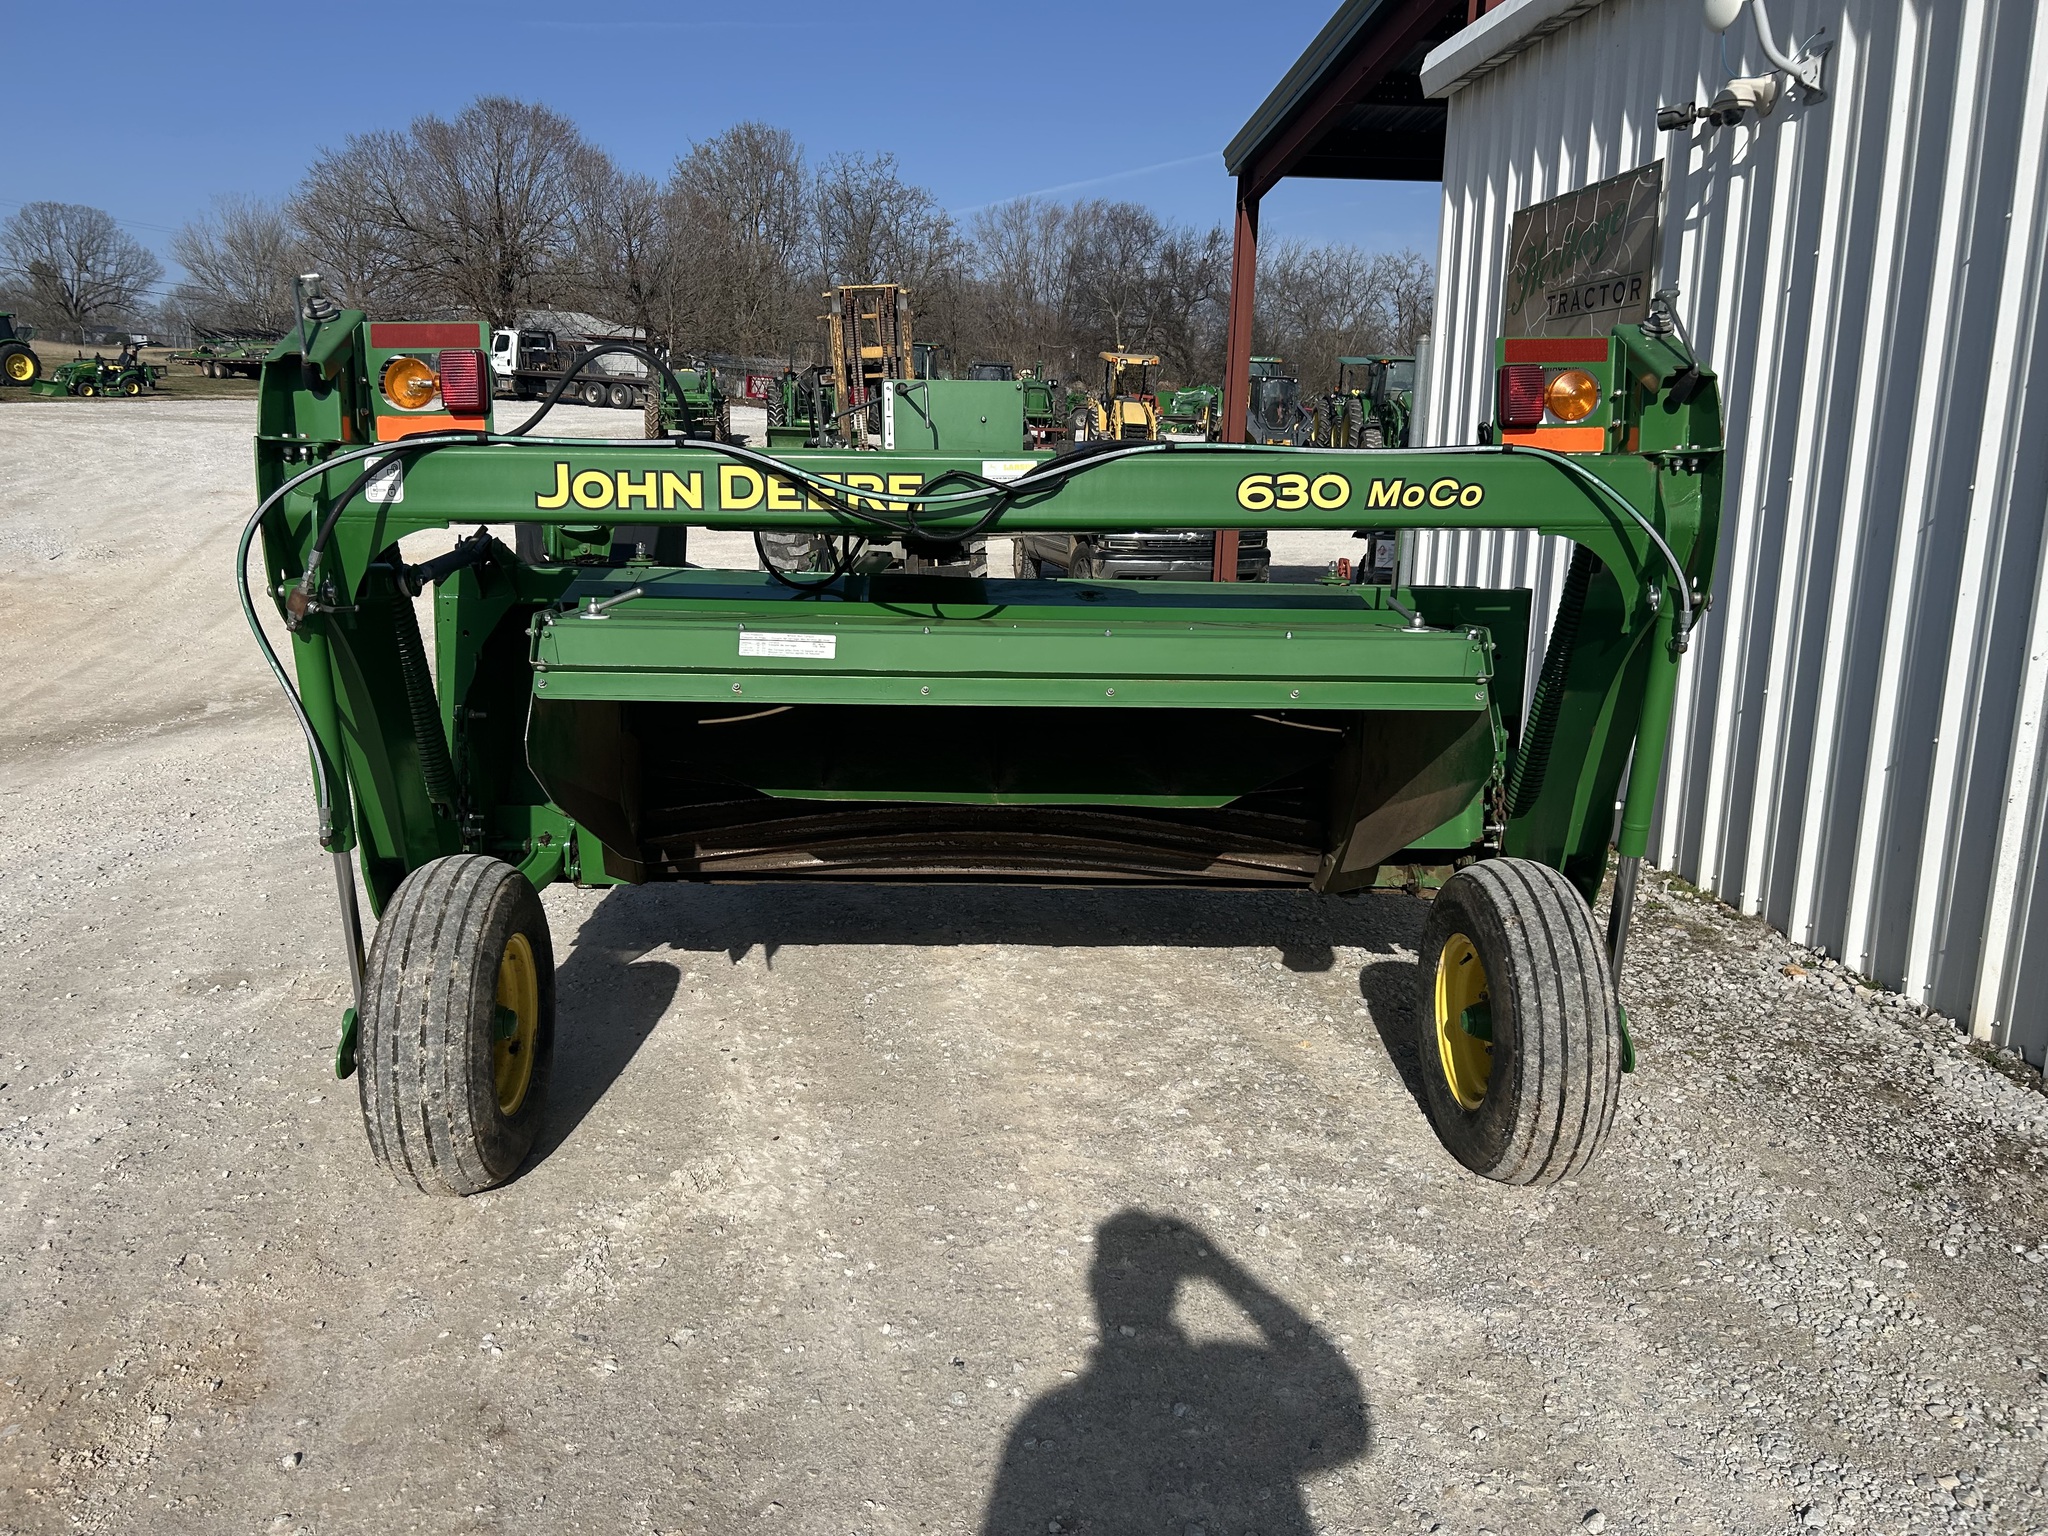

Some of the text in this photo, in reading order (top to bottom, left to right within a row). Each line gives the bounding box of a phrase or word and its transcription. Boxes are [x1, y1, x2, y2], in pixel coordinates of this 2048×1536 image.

[1547, 277, 1642, 316] TRACTOR
[536, 462, 925, 512] JOHN DEERE
[1237, 472, 1485, 511] 630 MoCo
